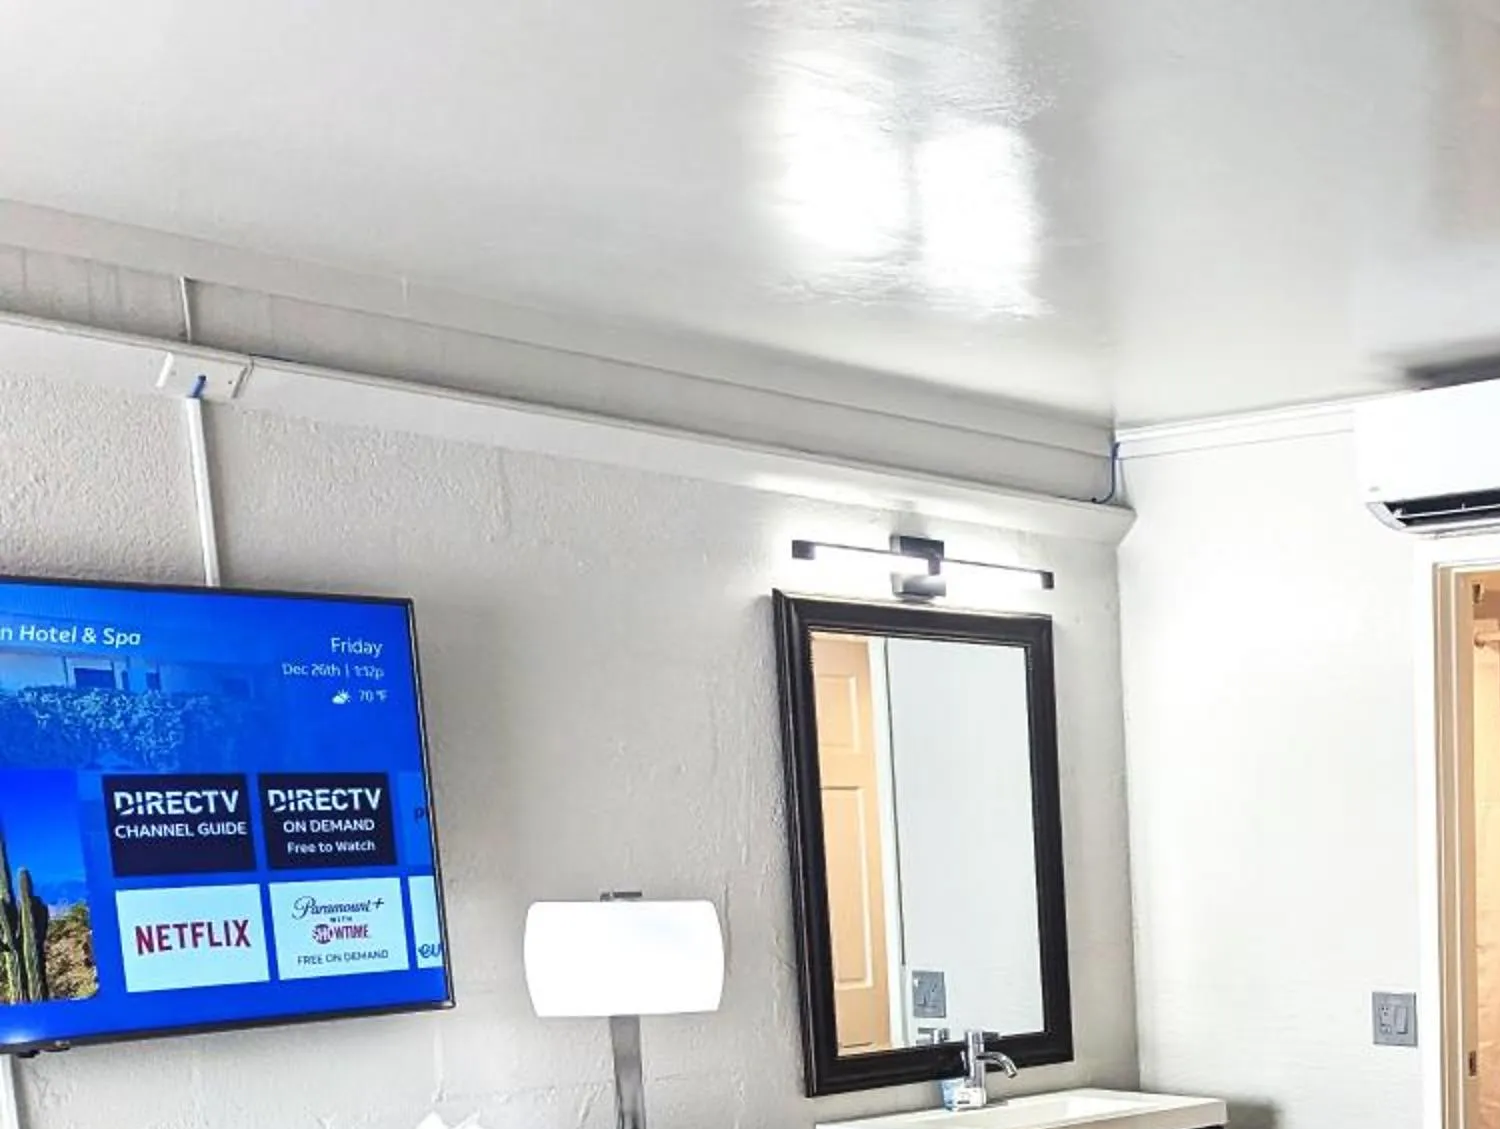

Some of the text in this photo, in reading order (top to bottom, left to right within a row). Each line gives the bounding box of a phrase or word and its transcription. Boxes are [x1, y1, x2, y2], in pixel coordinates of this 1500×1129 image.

[20, 624, 77, 644] Hotel
[82, 627, 97, 645] &
[102, 627, 141, 649] Spa
[330, 636, 384, 659] Friday
[282, 663, 309, 676] Dec
[311, 663, 341, 677] 26th
[113, 790, 239, 816] DIRECTV
[267, 788, 382, 813] DIRECTV
[114, 821, 248, 839] CHANNEL GUIDE
[283, 818, 375, 833] ON DEMAND
[287, 840, 376, 855] Free to Watch
[135, 919, 252, 956] NETFLIX
[312, 923, 370, 945] SHOWTIME
[297, 948, 389, 966] FREE ON DEMAND
